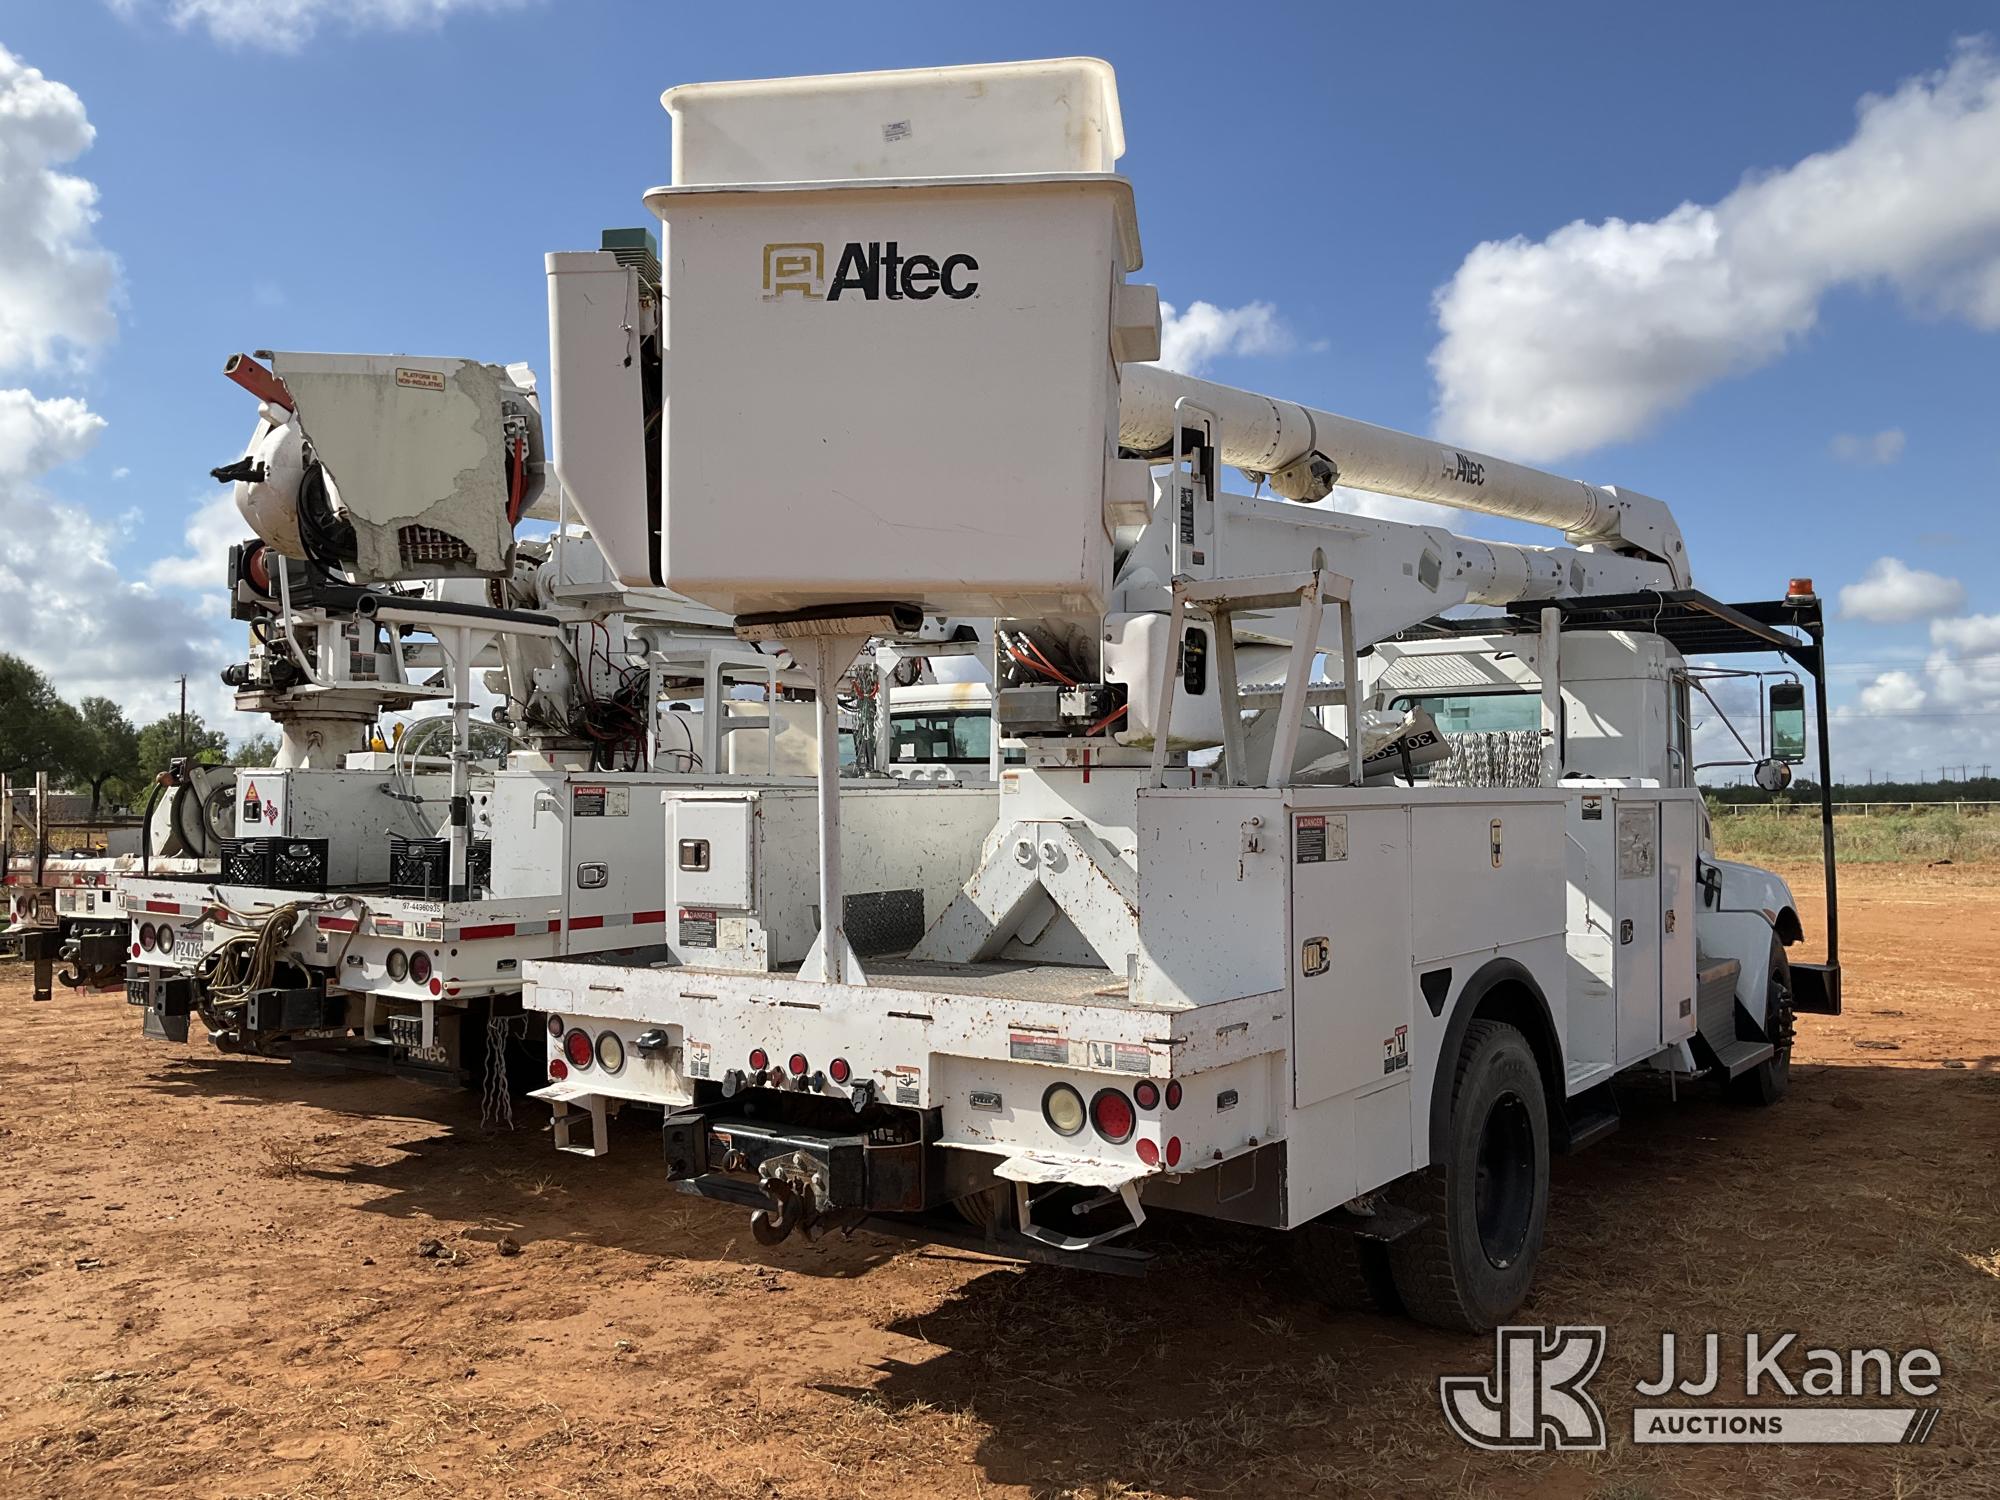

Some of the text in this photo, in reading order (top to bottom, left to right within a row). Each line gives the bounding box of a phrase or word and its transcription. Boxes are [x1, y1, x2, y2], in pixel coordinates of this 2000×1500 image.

[827, 241, 979, 300] Altec
[1454, 452, 1485, 486] Altec
[689, 911, 713, 920] DANGER
